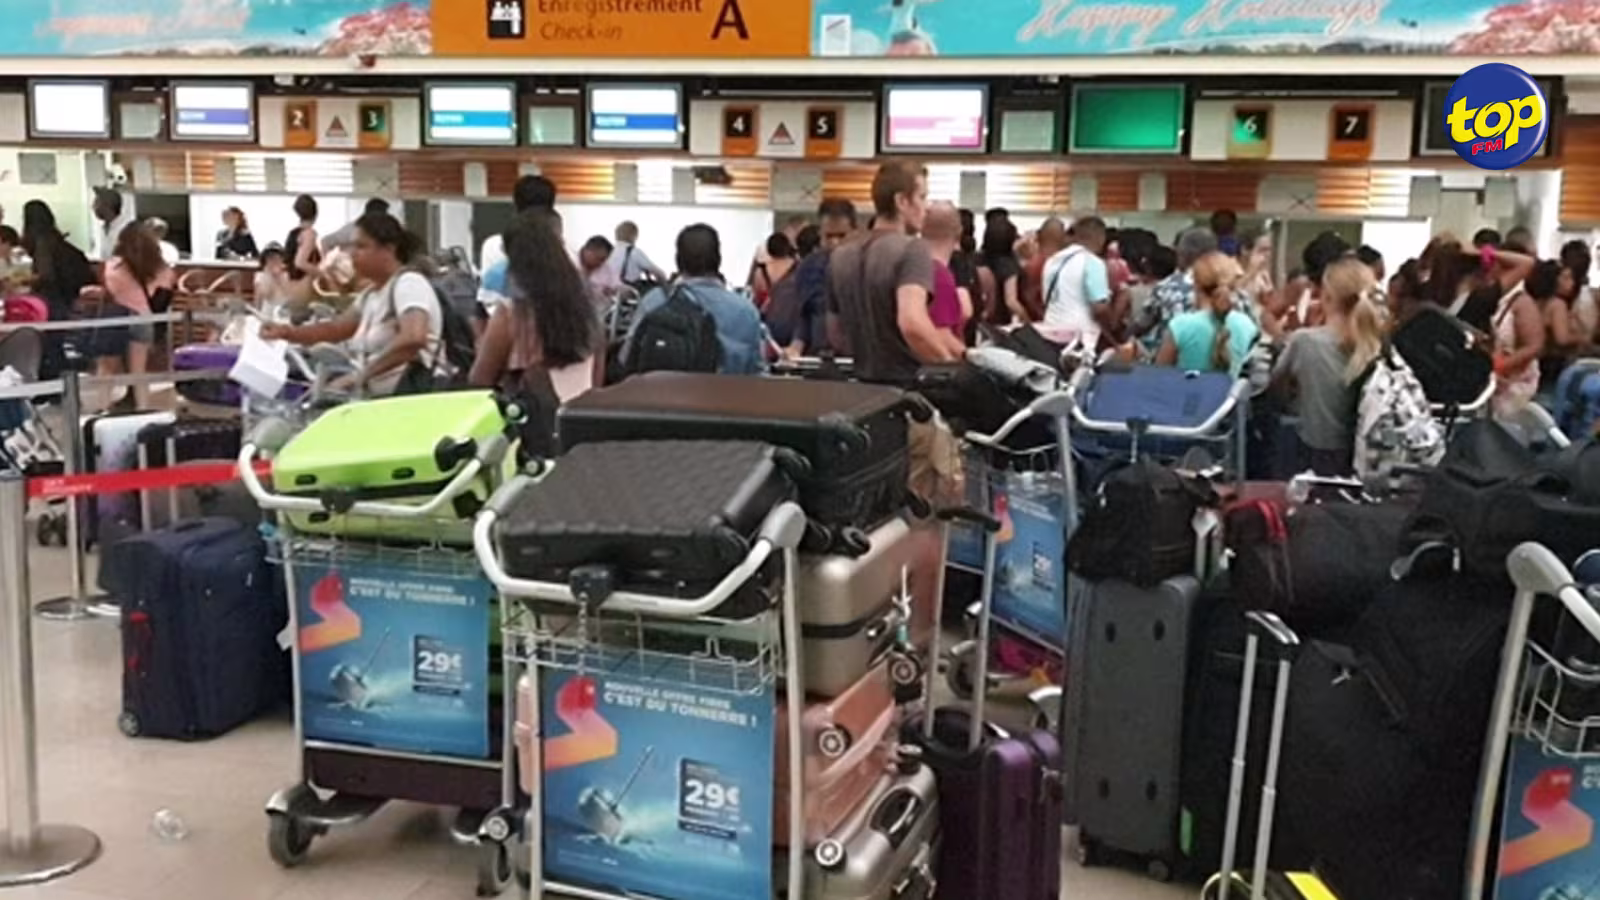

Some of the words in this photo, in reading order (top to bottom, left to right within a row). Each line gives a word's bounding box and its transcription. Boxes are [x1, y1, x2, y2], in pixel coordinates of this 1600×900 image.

[711, 0, 749, 39] A
[539, 22, 623, 40] Check-in
[367, 110, 378, 128] 3
[732, 116, 744, 132] 4
[816, 116, 828, 134] 5
[1243, 115, 1258, 133] 6
[1344, 116, 1358, 134] 7
[603, 690, 642, 707] C'EST
[645, 698, 667, 713] DU
[671, 702, 748, 727] TONNERRE
